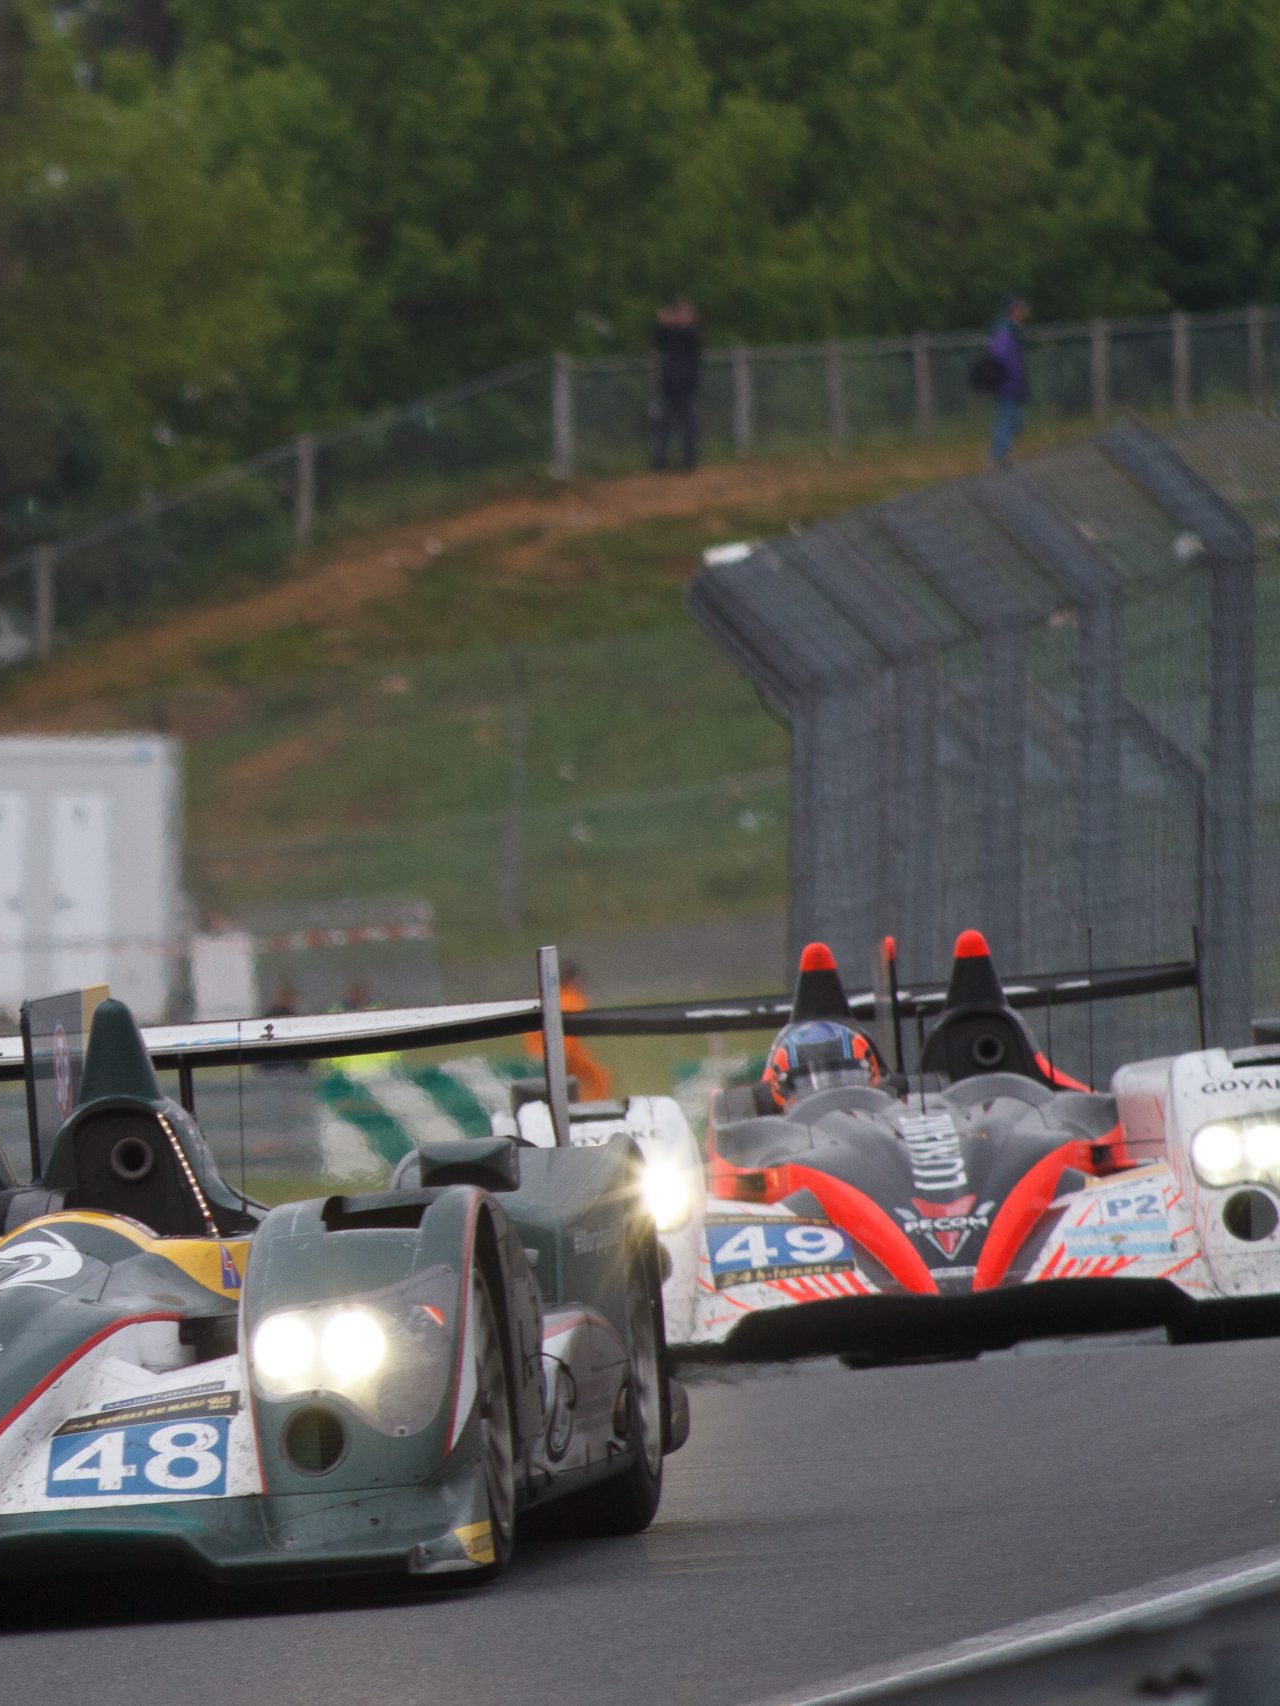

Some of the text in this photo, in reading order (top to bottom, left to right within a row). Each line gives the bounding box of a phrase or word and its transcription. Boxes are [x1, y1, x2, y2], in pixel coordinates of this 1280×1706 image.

[1106, 1193, 1162, 1218] P2
[903, 1217, 989, 1233] PECOM
[715, 1225, 845, 1268] 49
[52, 1422, 222, 1491] 48
